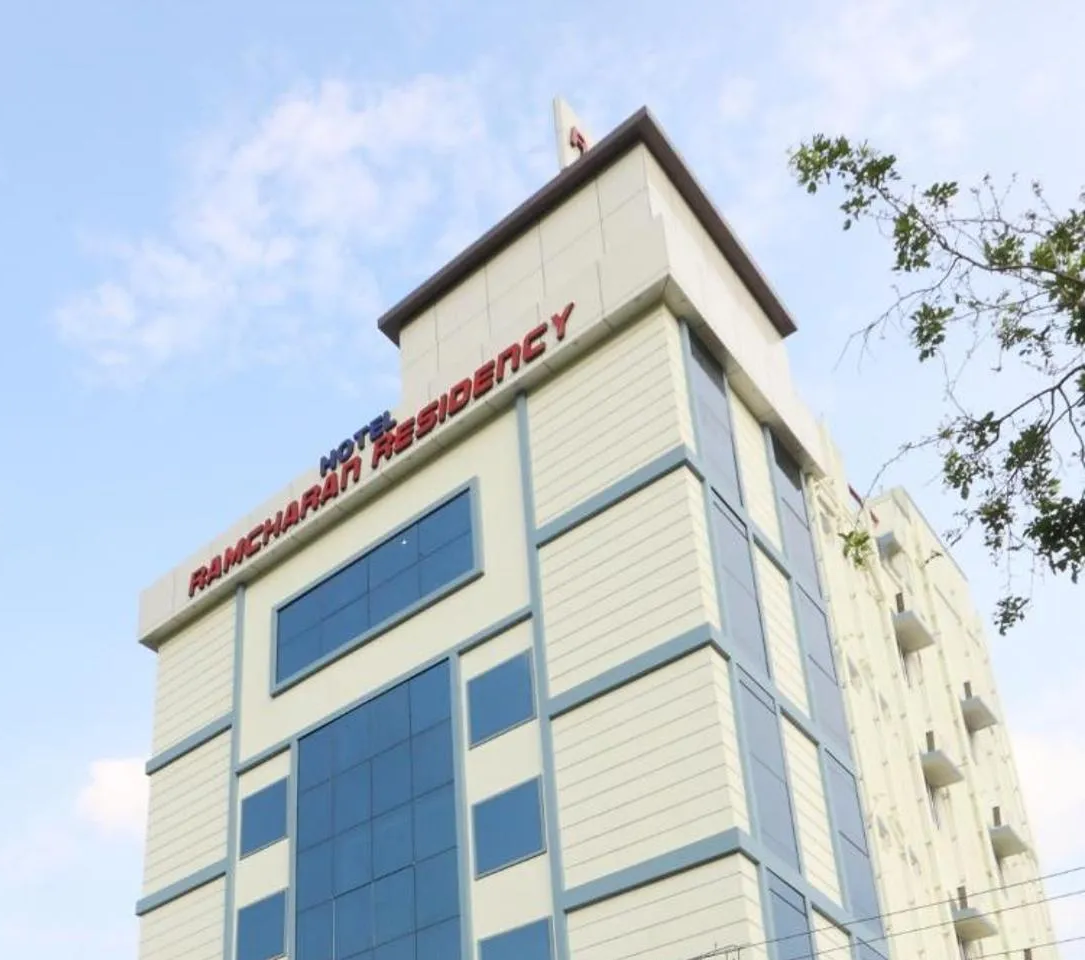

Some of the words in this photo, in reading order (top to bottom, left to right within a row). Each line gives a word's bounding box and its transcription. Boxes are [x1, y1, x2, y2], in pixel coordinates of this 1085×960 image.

[188, 455, 362, 598] RAMCHARAN
[371, 302, 575, 470] RESIDENCY
[320, 410, 396, 477] HOTEL
